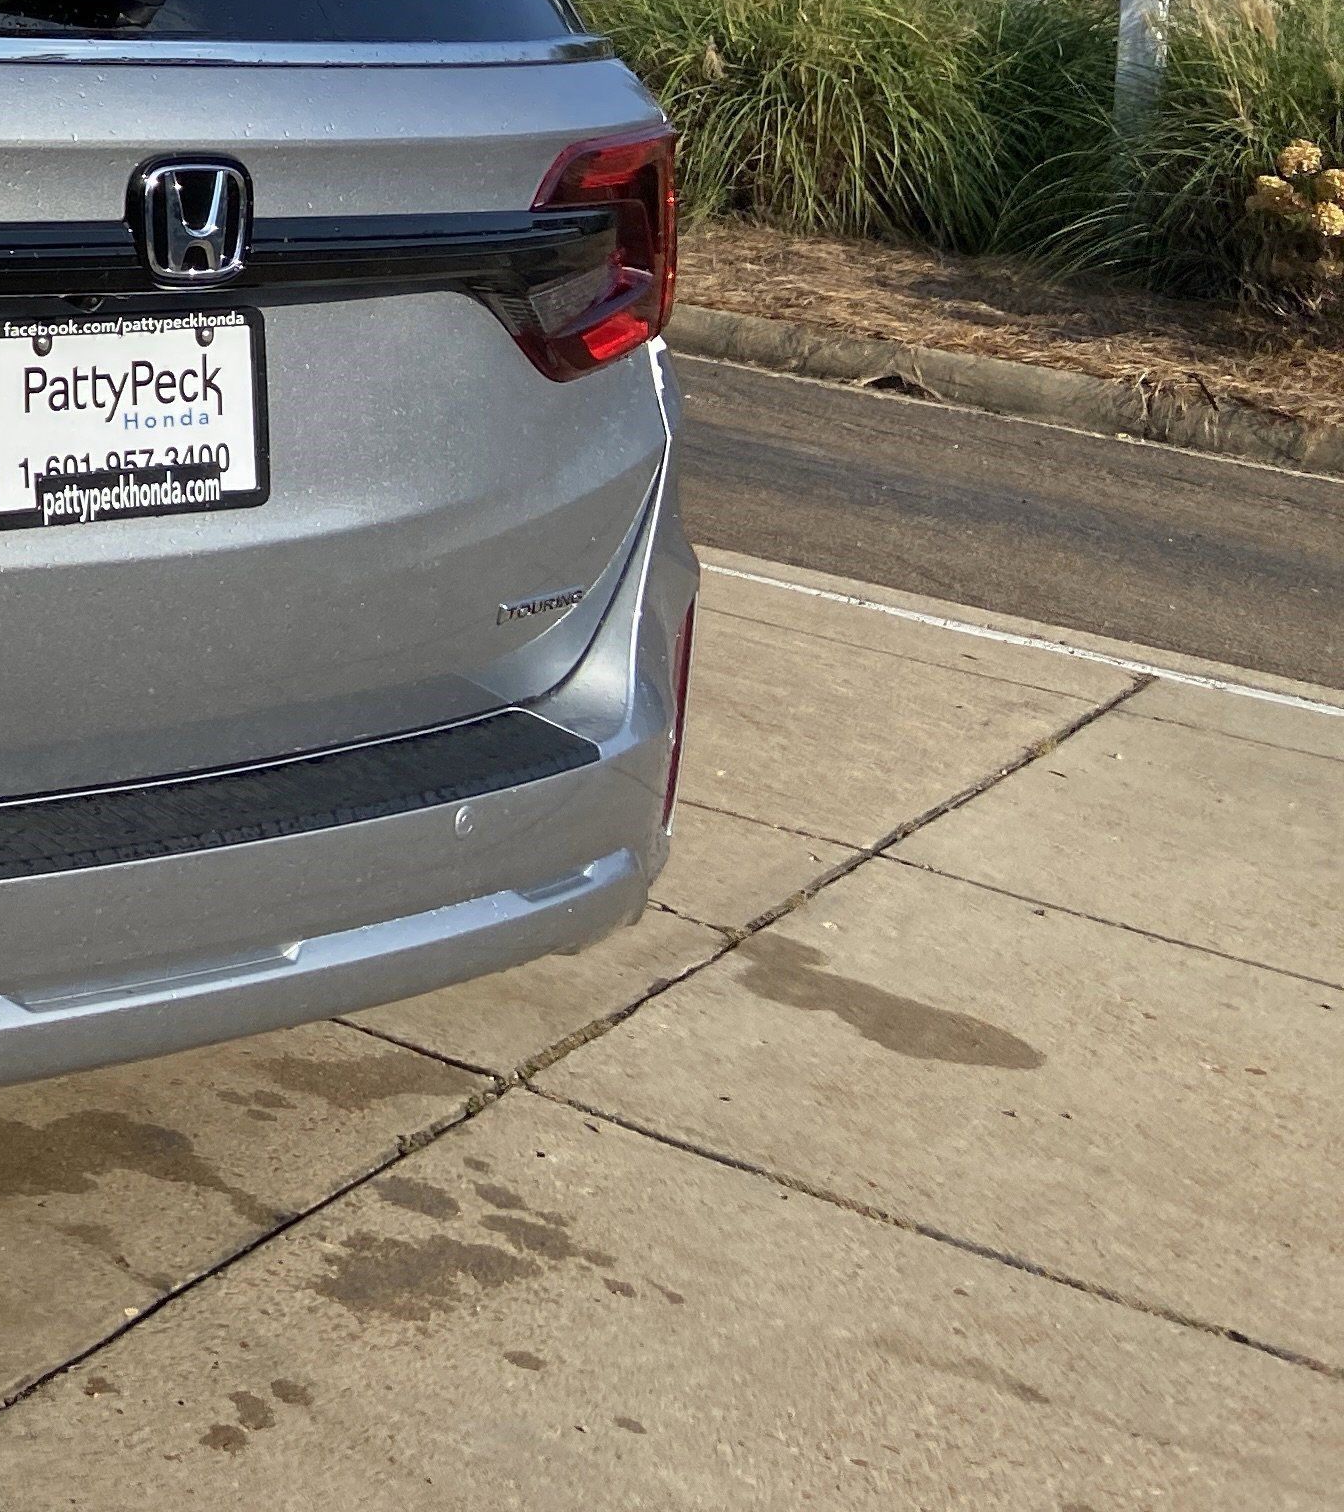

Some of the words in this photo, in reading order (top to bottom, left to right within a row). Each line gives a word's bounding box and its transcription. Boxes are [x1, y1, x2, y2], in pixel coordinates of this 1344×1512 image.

[3, 311, 245, 338] facebook.com/pattypeckhonda
[24, 354, 223, 423] PattyPeck
[124, 408, 210, 430] Honda
[43, 471, 221, 526] pattypeckhonda.com
